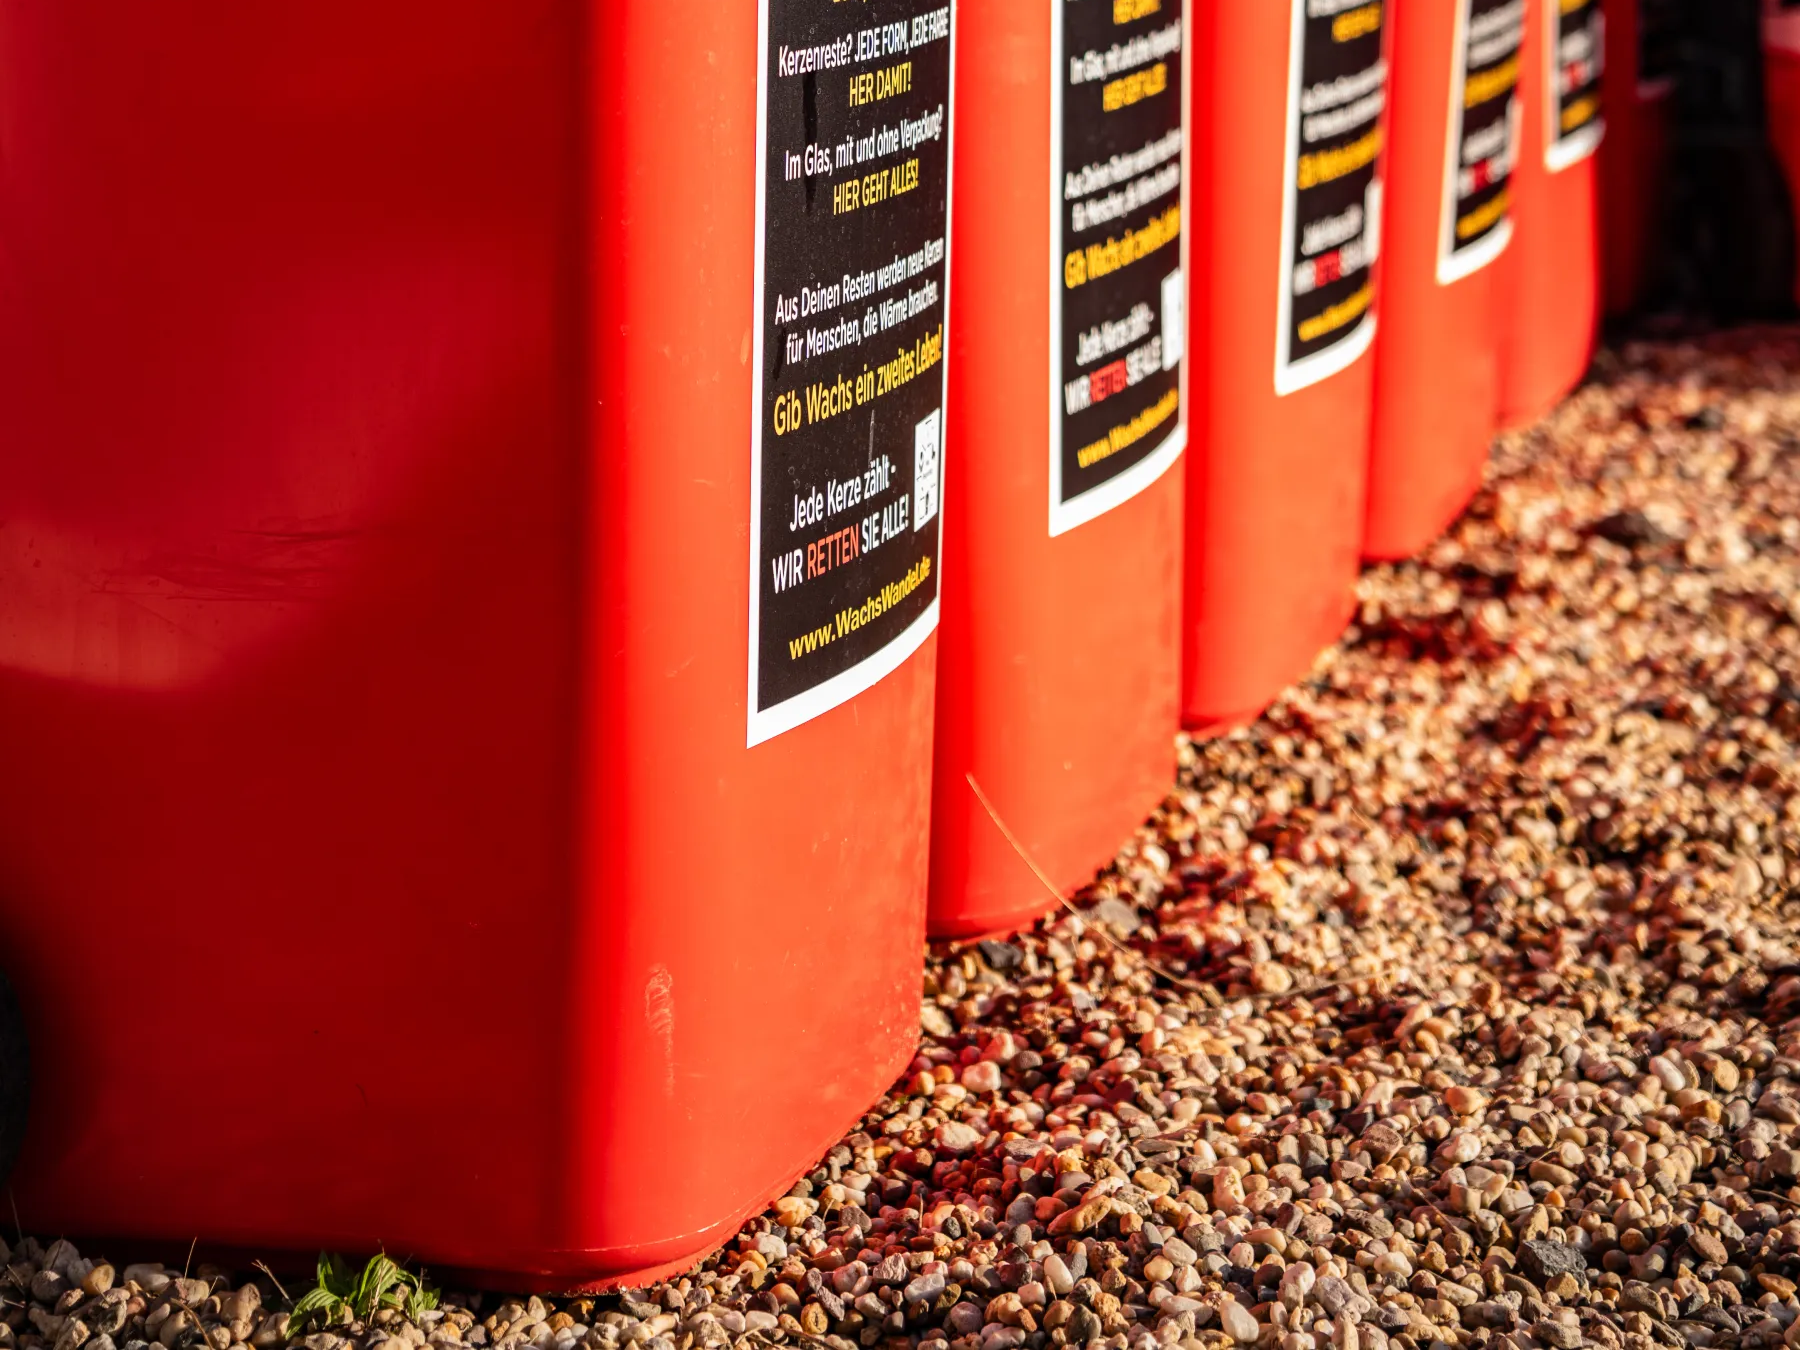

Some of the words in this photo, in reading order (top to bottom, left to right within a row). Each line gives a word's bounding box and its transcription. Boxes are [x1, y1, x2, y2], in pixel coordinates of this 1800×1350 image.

[779, 32, 852, 77] Kerzenreste?
[854, 27, 881, 62] JEDE
[882, 20, 909, 55] FORM,
[910, 13, 929, 48] JEDE
[849, 73, 874, 107] HER
[876, 61, 912, 100] DAMIT!
[785, 150, 801, 181] Im
[804, 141, 833, 177] Glas,
[835, 135, 854, 173] mit
[856, 127, 876, 164] und
[877, 124, 899, 158] ohne
[833, 177, 860, 215] HIER
[862, 169, 889, 206] GEHT
[890, 158, 919, 198] ALLES!
[775, 293, 798, 326] Aus
[801, 282, 840, 318] Deinen
[843, 270, 875, 304] Resten
[877, 254, 906, 291] werden
[907, 249, 924, 278] neue
[786, 332, 804, 365] für
[806, 317, 861, 359] Menschen,
[863, 306, 878, 338] die
[879, 297, 907, 331] Wärme
[773, 389, 801, 436] Gib
[806, 373, 852, 425] Wachs
[856, 363, 874, 406] ein
[876, 347, 914, 397] zweites
[789, 486, 824, 532] Jede
[827, 475, 861, 517] Kerze
[864, 454, 890, 499] zählt
[772, 548, 803, 594] WIR
[807, 523, 859, 580] RETTEN
[862, 511, 880, 554] SIE
[881, 493, 909, 544] ALLE!
[789, 555, 931, 660] www.WachsWandel.de
